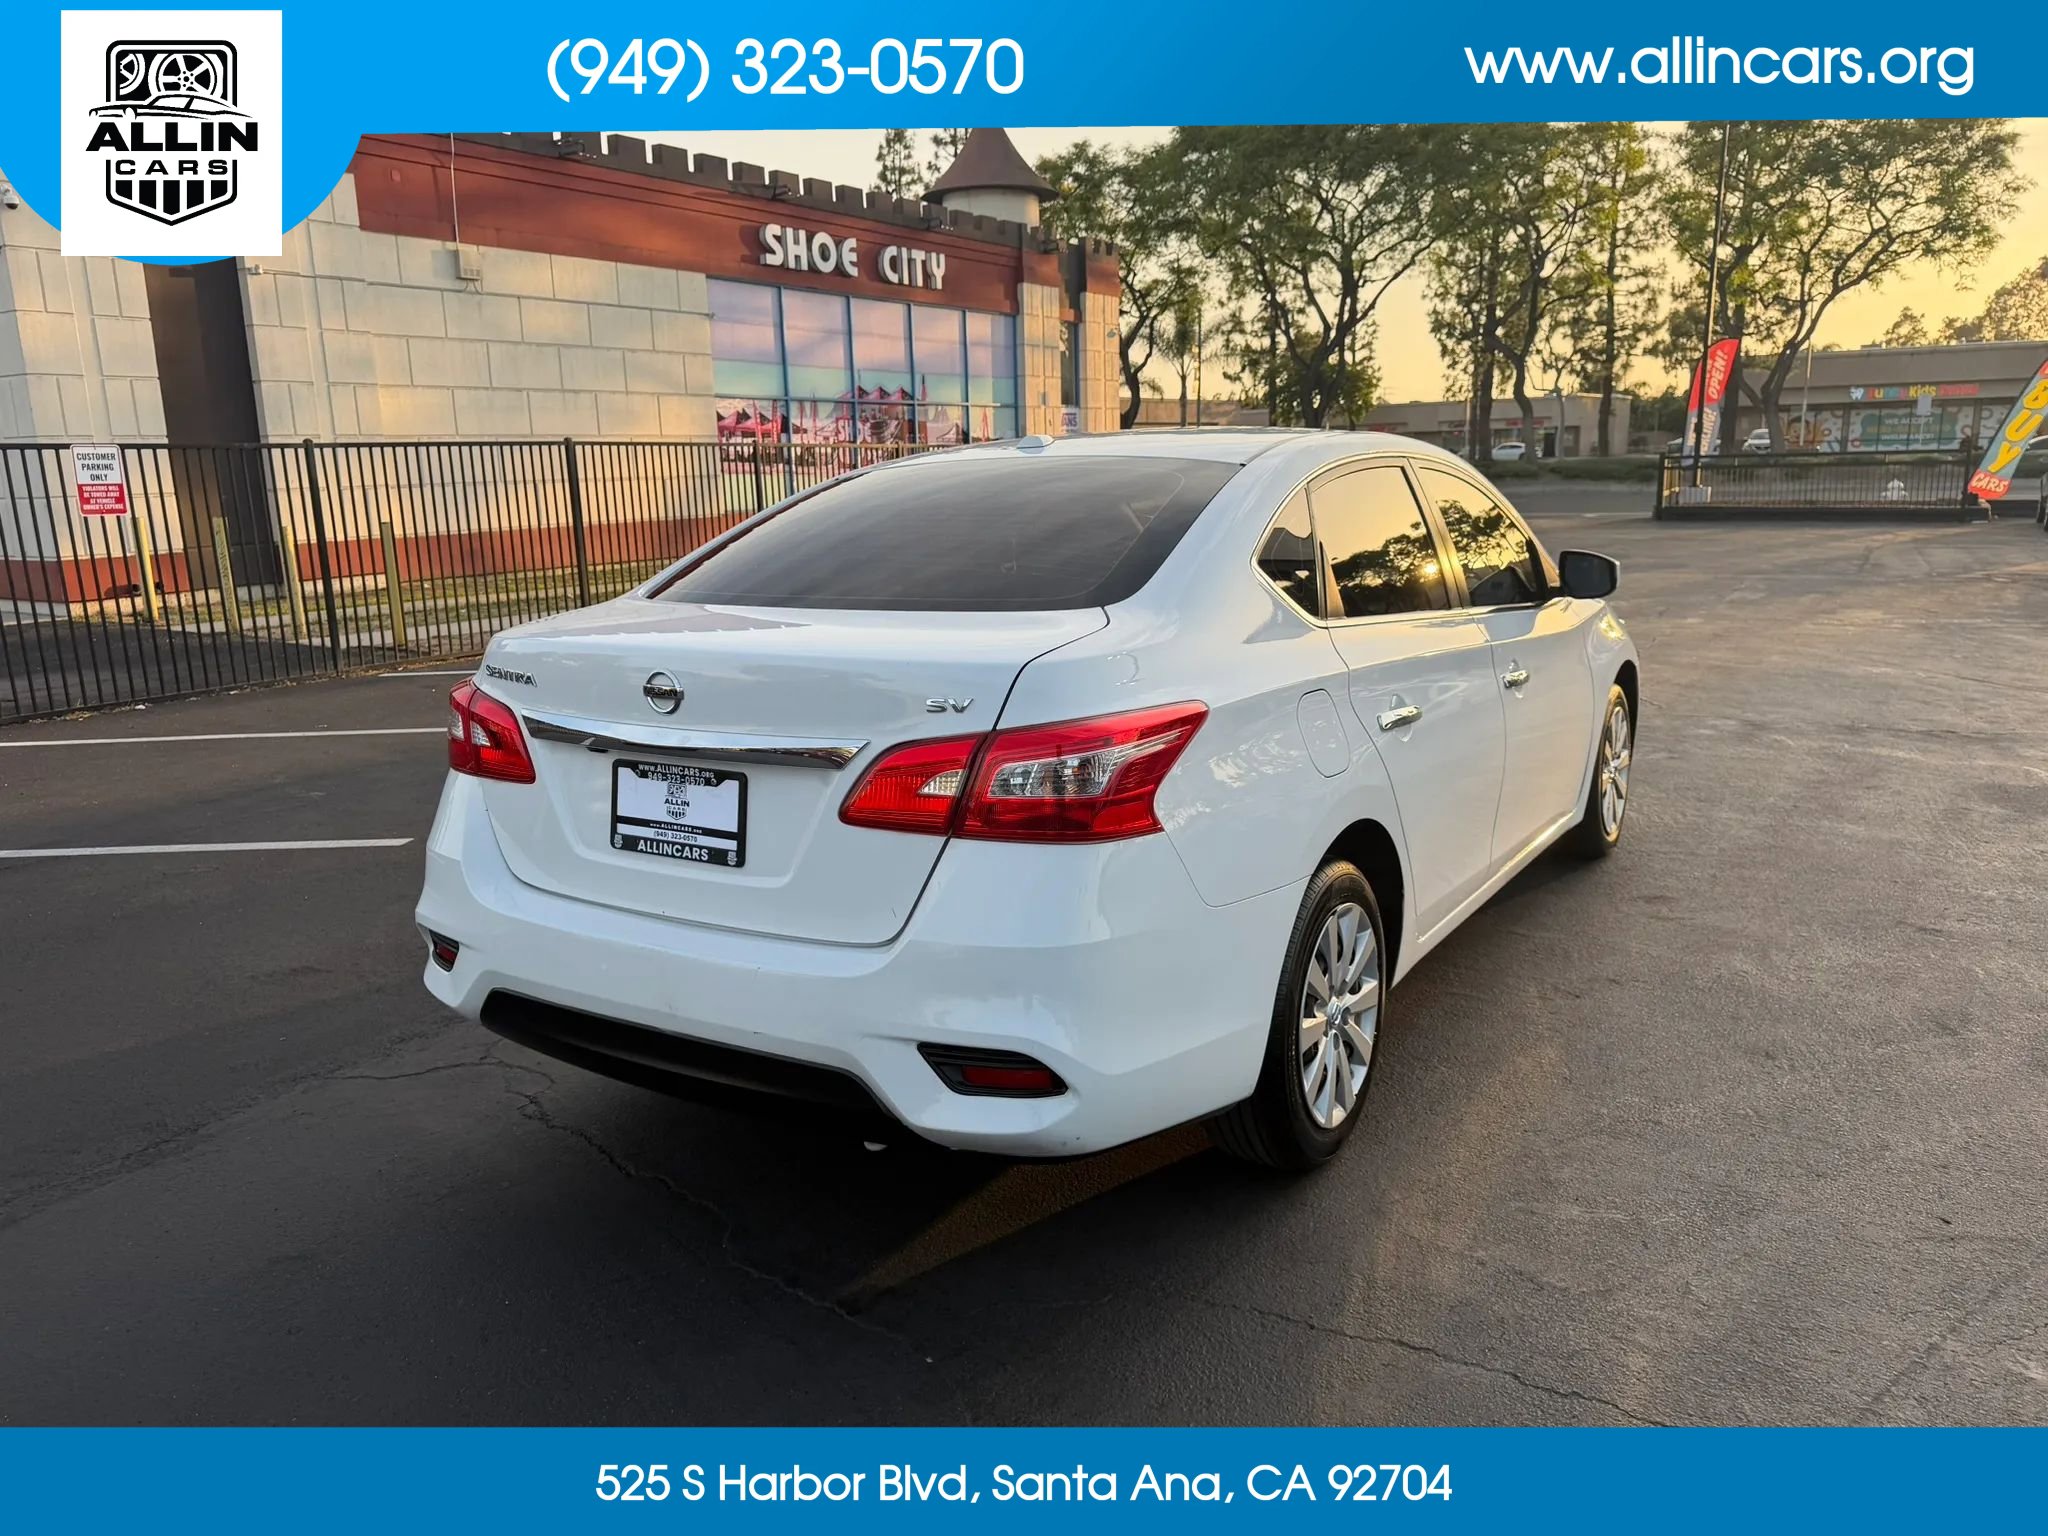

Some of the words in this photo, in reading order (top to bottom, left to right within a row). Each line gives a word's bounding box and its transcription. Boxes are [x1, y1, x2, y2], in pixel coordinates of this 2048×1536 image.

[760, 223, 859, 277] SHOE
[878, 245, 946, 290] CITY
[1708, 350, 1729, 400] OPEN!
[1987, 378, 2048, 473] BUY
[76, 452, 116, 461] CUSTOMER
[82, 463, 114, 471] PARKING
[90, 473, 108, 482] ONLY
[1971, 473, 2009, 493] CARS
[486, 664, 537, 687] SENTRA
[926, 698, 974, 713] SV
[647, 771, 706, 787] 949-323-0570
[664, 798, 690, 807] ALLIN
[653, 829, 670, 840] (949)
[670, 831, 698, 843] 323-0570
[637, 839, 709, 861] ALLINCARS
